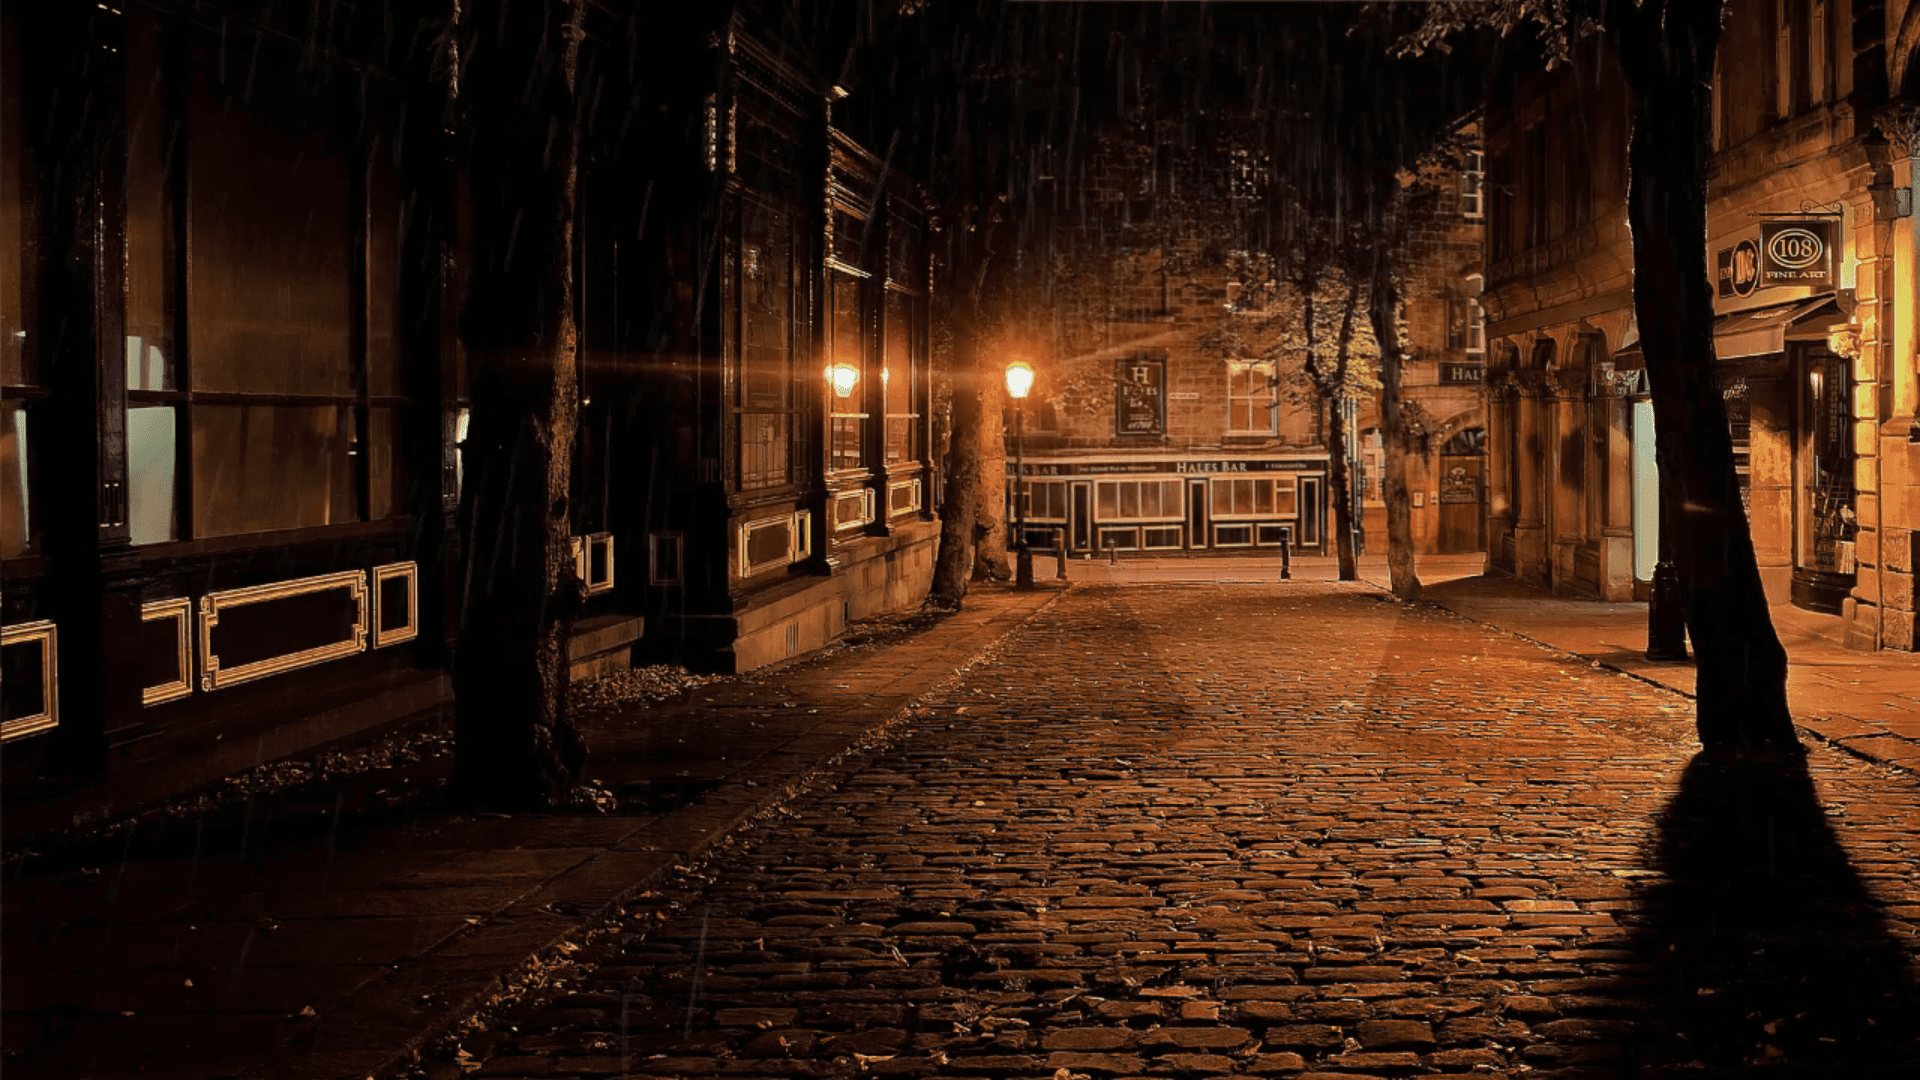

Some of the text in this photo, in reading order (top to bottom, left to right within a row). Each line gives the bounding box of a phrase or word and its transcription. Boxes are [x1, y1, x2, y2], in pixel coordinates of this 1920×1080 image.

[1780, 239, 1813, 257] 108
[1766, 270, 1826, 279] FINE ART
[1131, 366, 1150, 384] H
[1032, 464, 1059, 476] BAR
[1176, 460, 1248, 474] HALES BAR
